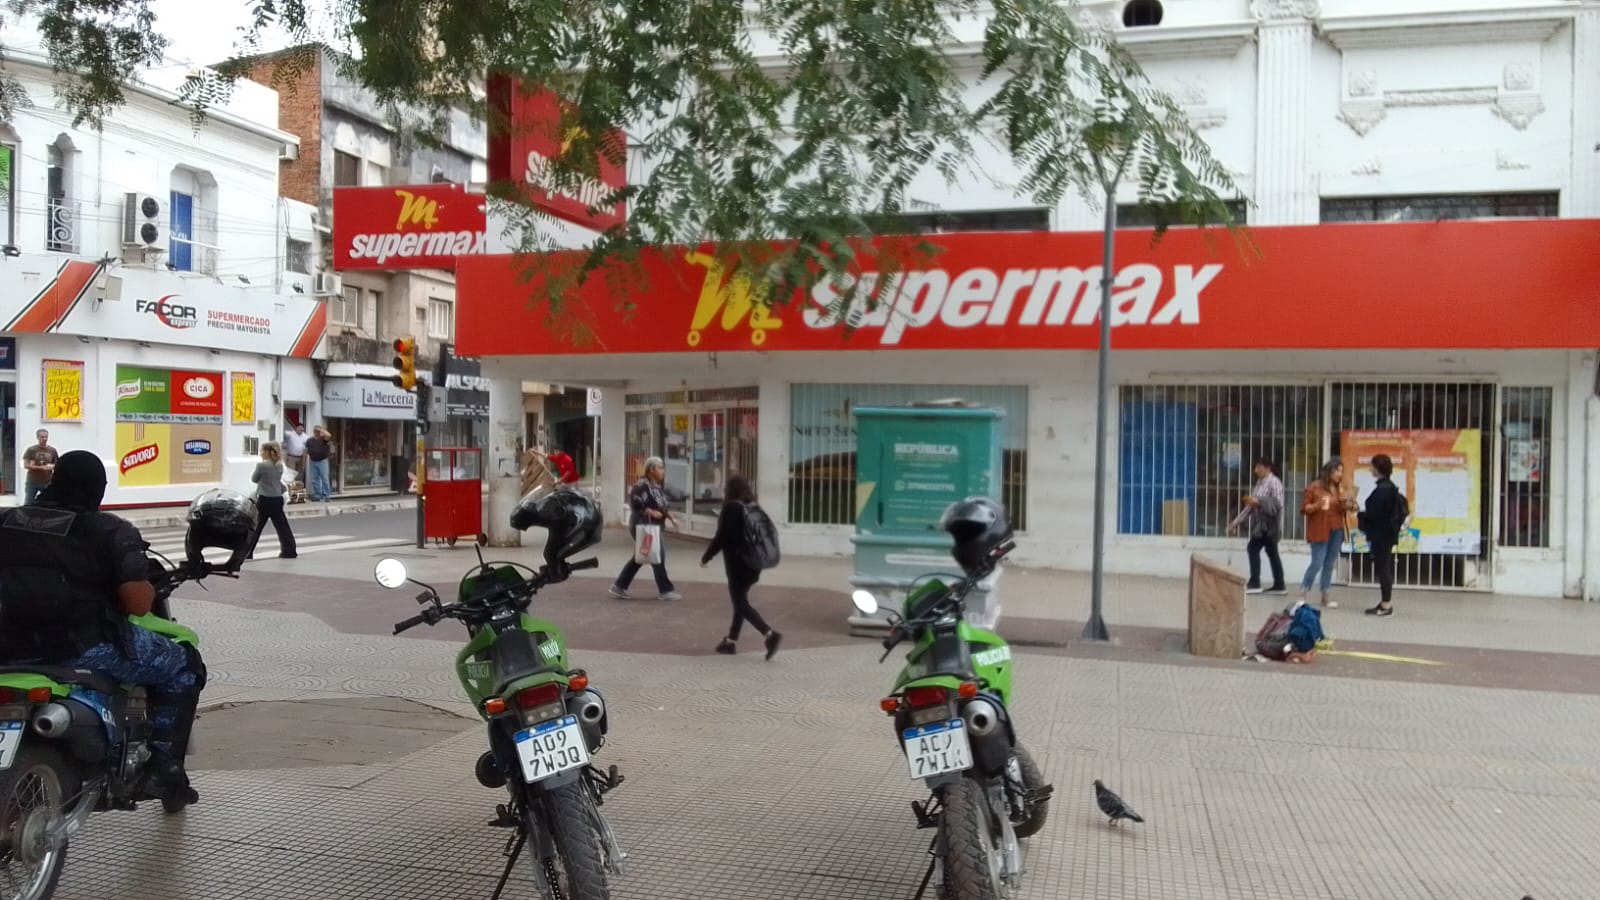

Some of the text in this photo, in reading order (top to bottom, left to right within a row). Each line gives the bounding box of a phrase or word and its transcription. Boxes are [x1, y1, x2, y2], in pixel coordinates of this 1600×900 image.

[349, 230, 487, 264] supermax
[135, 299, 197, 319] FACOR
[802, 263, 1223, 345] supermax
[207, 310, 271, 327] SUPERMERCADO
[207, 321, 271, 335] PRECIOS MAYORISTA
[189, 385, 208, 393] CICA
[529, 746, 581, 777] 7WJQ
